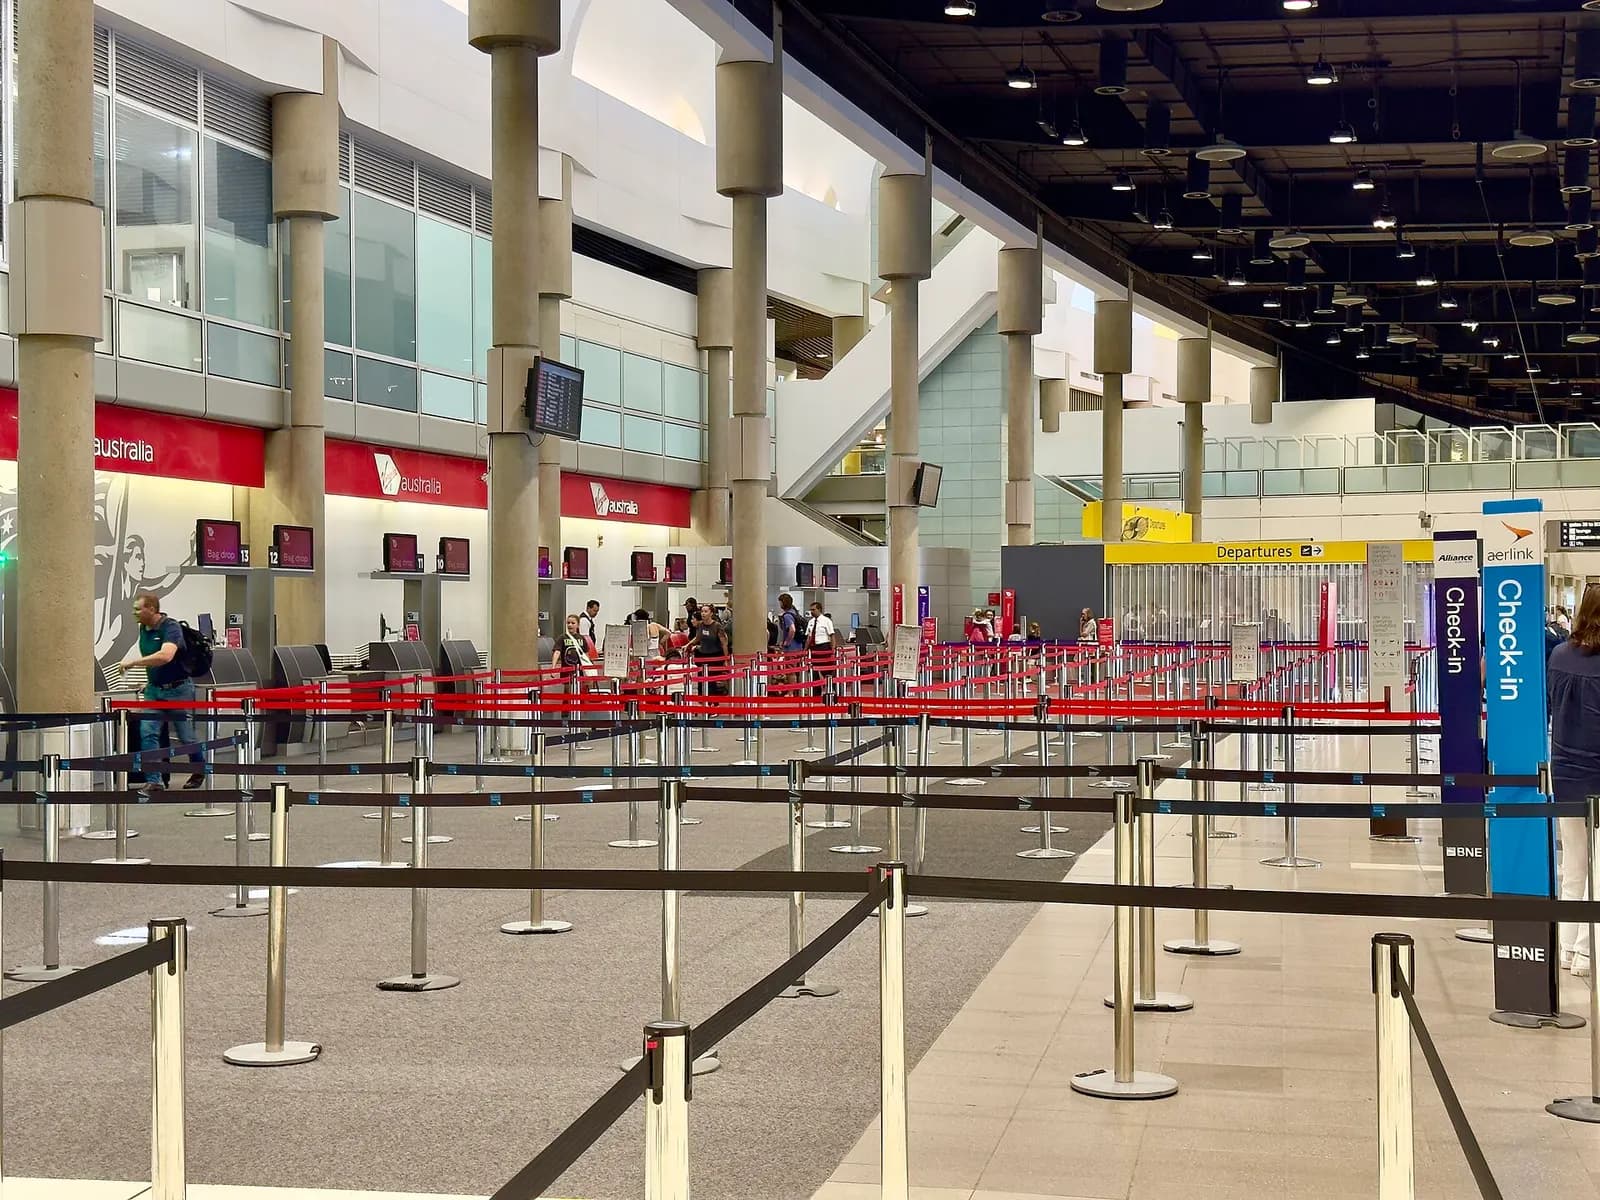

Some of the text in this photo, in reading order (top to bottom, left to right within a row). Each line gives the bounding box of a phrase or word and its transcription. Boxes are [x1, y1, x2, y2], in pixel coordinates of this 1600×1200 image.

[94, 437, 154, 462] australia
[401, 476, 441, 495] australia
[609, 499, 639, 515] australia
[207, 549, 236, 561] Bag drop
[241, 550, 249, 562] 13
[269, 552, 279, 564] 12
[1217, 546, 1293, 560] Departures
[1438, 554, 1474, 562] Alliance
[1487, 547, 1534, 561] aerlink
[417, 558, 424, 569] 11
[437, 559, 444, 570] 10
[1446, 587, 1466, 674] Check-in
[1497, 579, 1524, 701] Check-in
[1456, 847, 1483, 857] BNE
[1511, 945, 1545, 962] BNE
